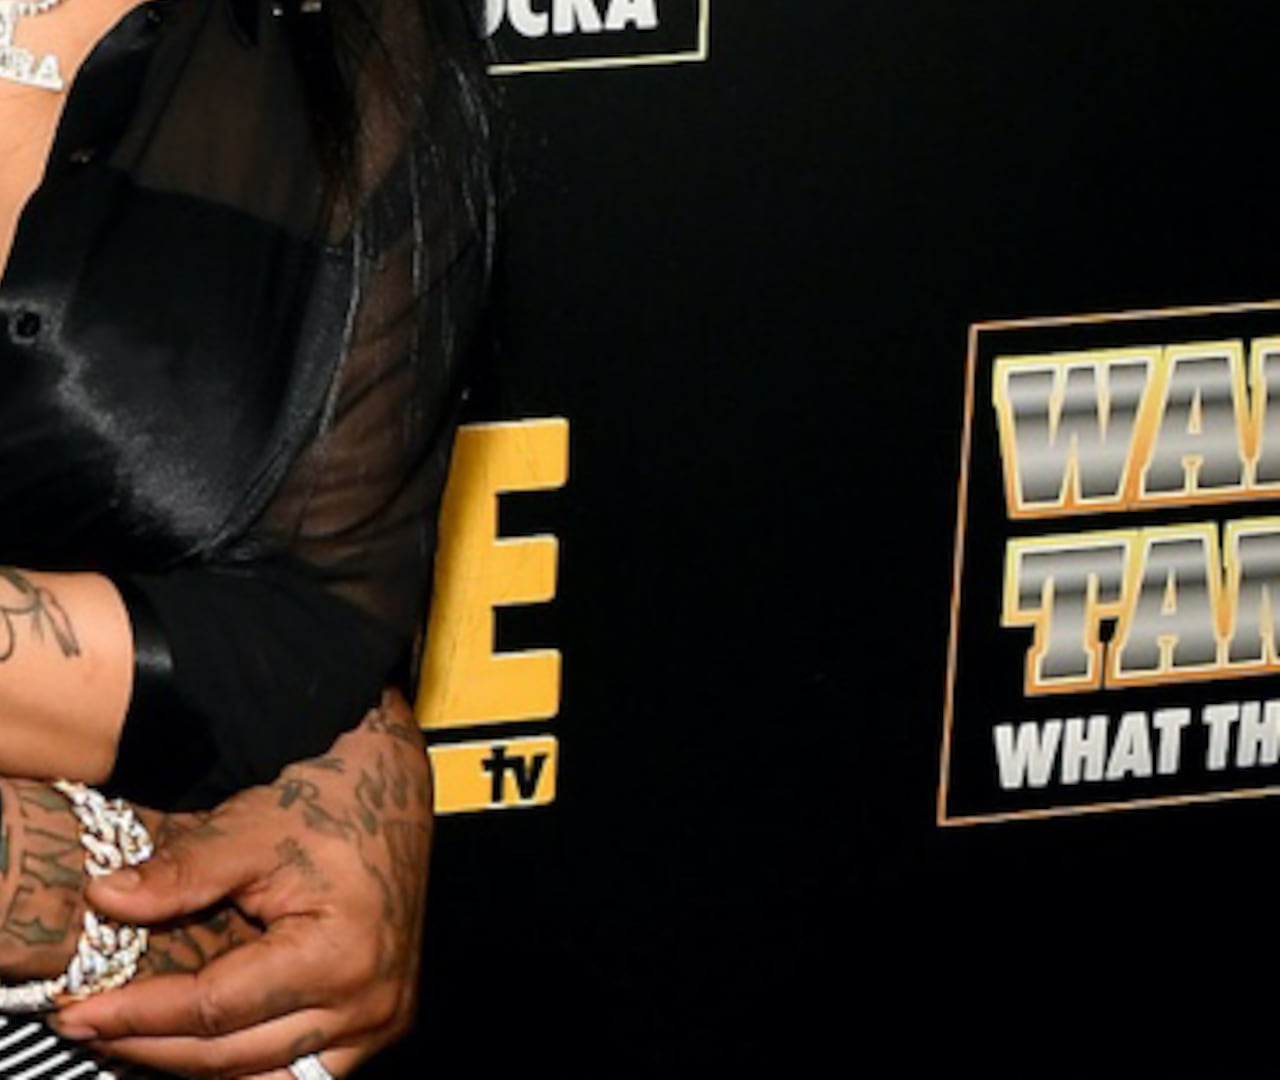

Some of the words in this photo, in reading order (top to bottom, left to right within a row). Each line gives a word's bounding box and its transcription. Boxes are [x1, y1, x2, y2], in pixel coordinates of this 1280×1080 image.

[992, 336, 1280, 520] WA
[481, 745, 549, 804] tv
[993, 707, 1191, 790] WHAT
[1202, 700, 1280, 771] TH
